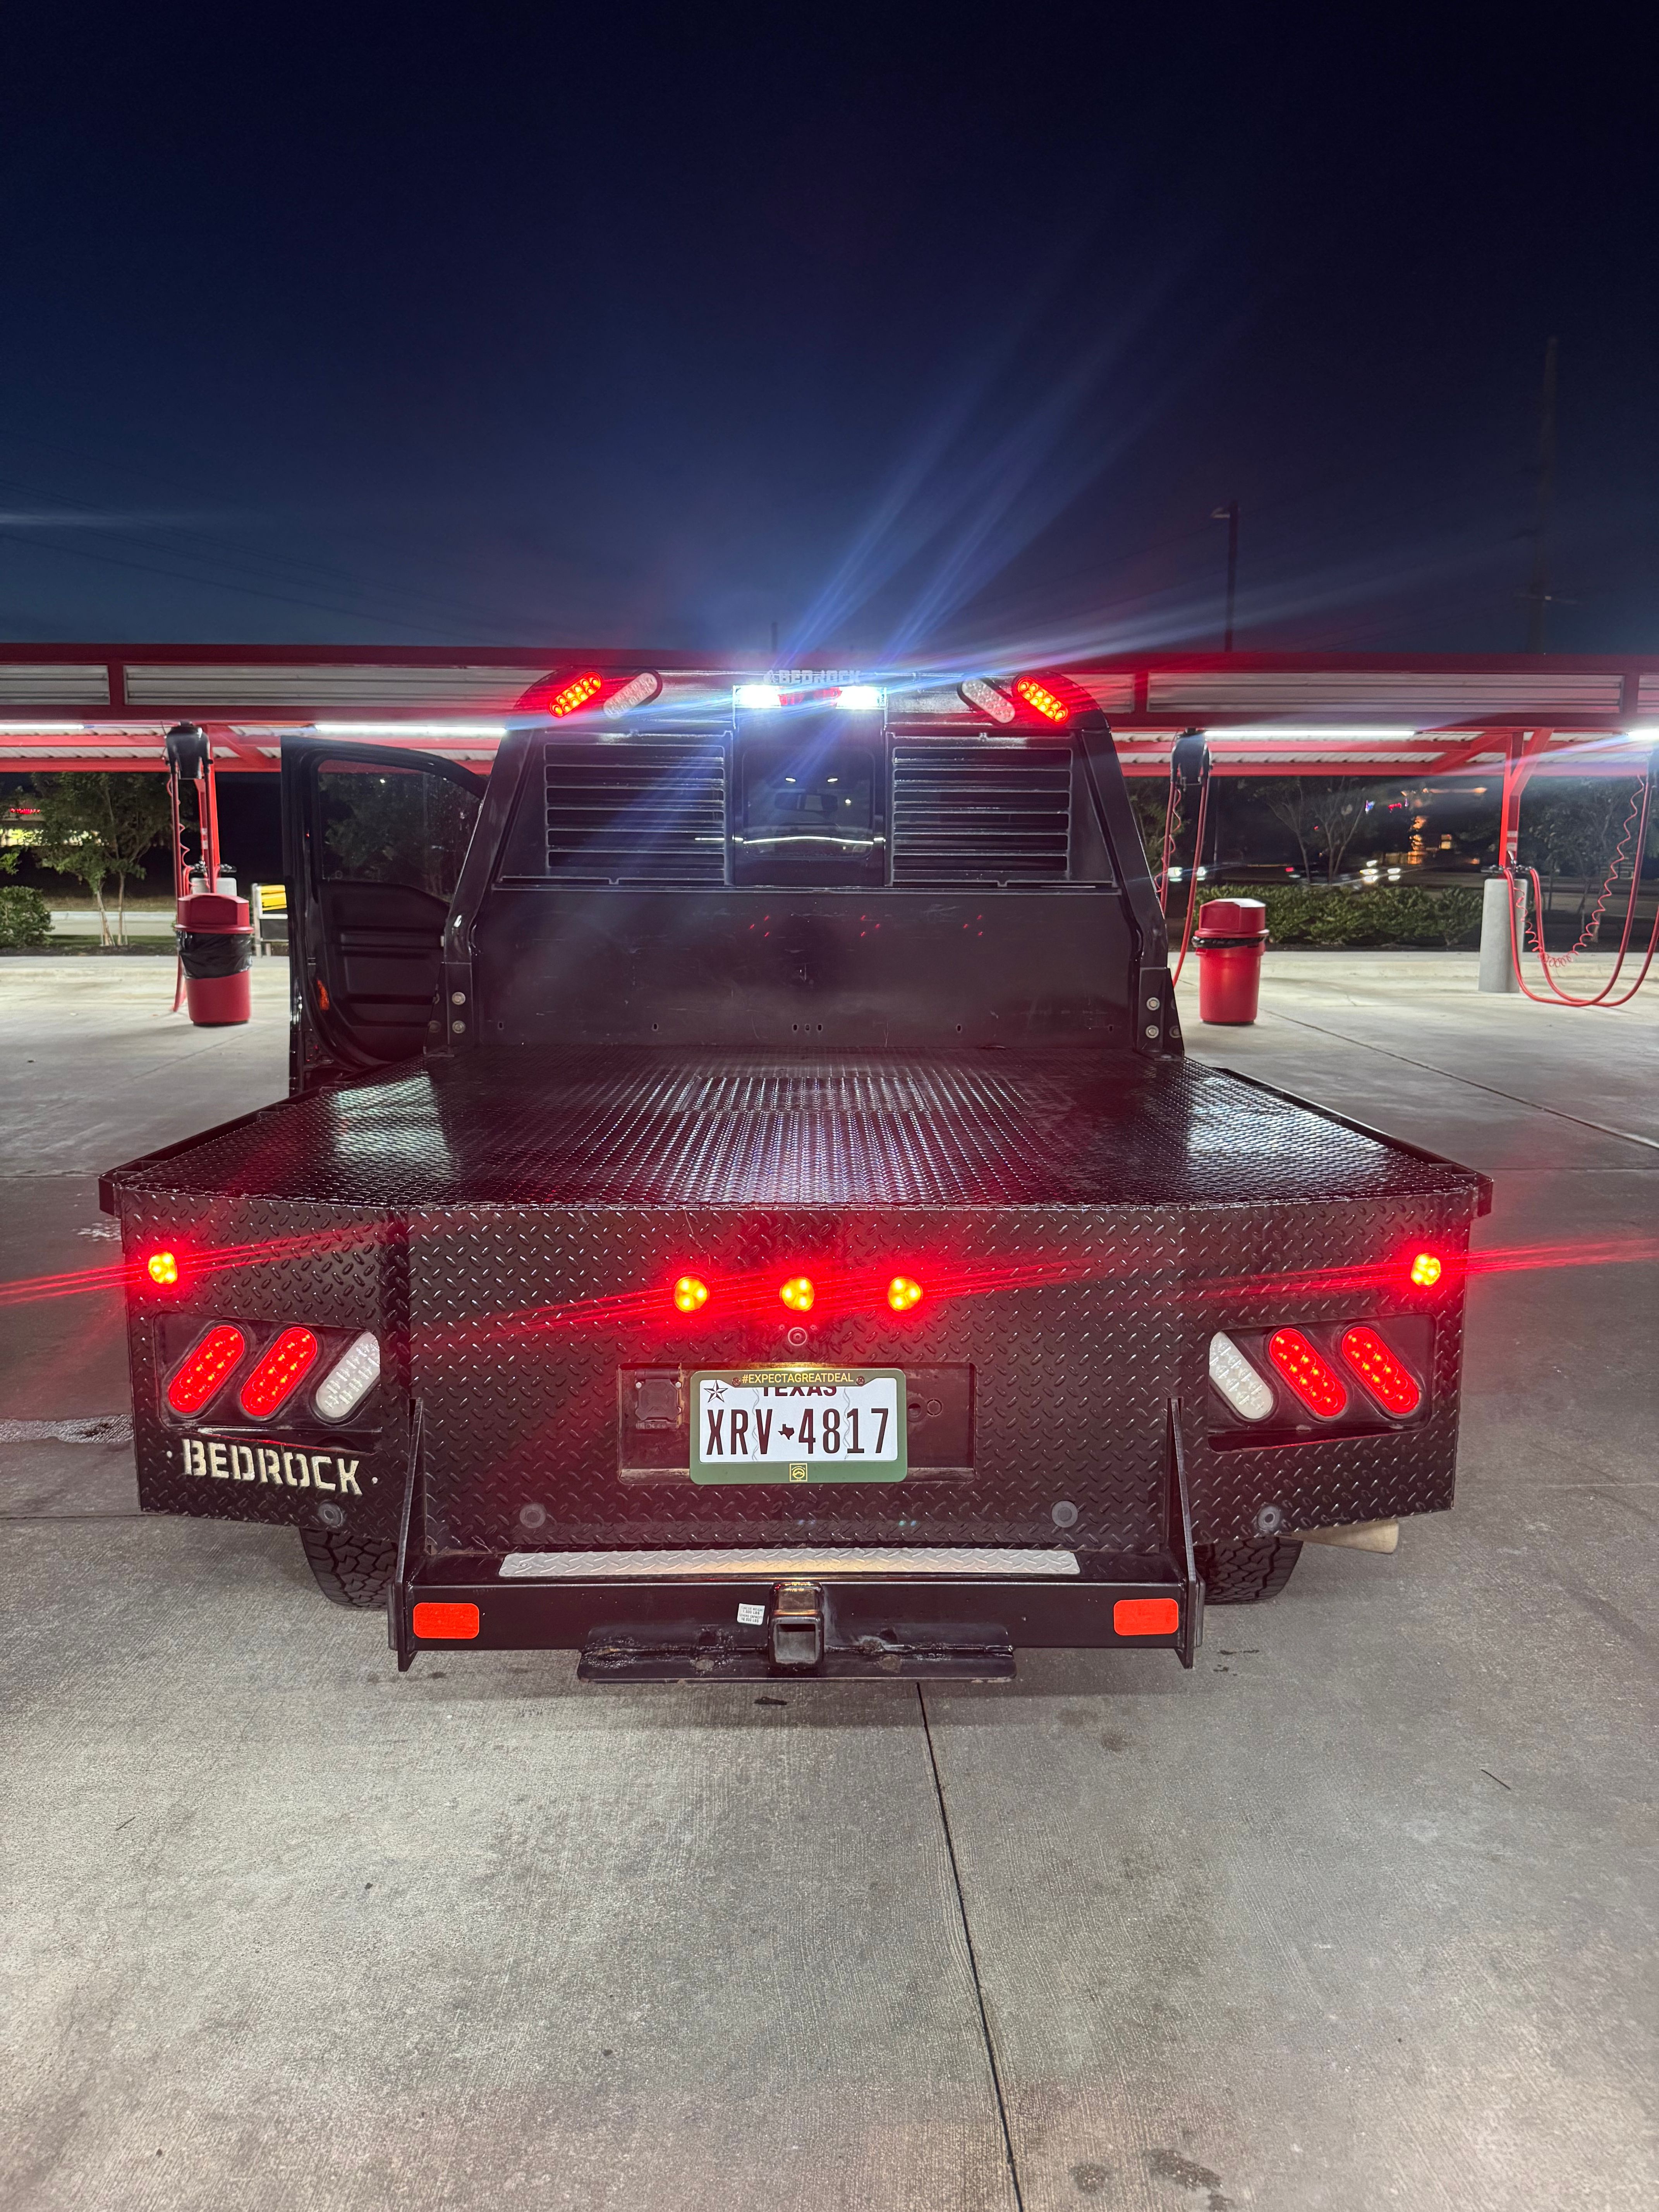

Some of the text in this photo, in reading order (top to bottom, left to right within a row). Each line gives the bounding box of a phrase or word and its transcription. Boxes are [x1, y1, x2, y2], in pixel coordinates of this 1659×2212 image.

[778, 670, 861, 684] BEDROCK
[742, 1373, 854, 1383] #EXPECTAGREATDEAL
[706, 1408, 889, 1455] XRV 4817
[181, 1438, 363, 1496] BEDROCK
